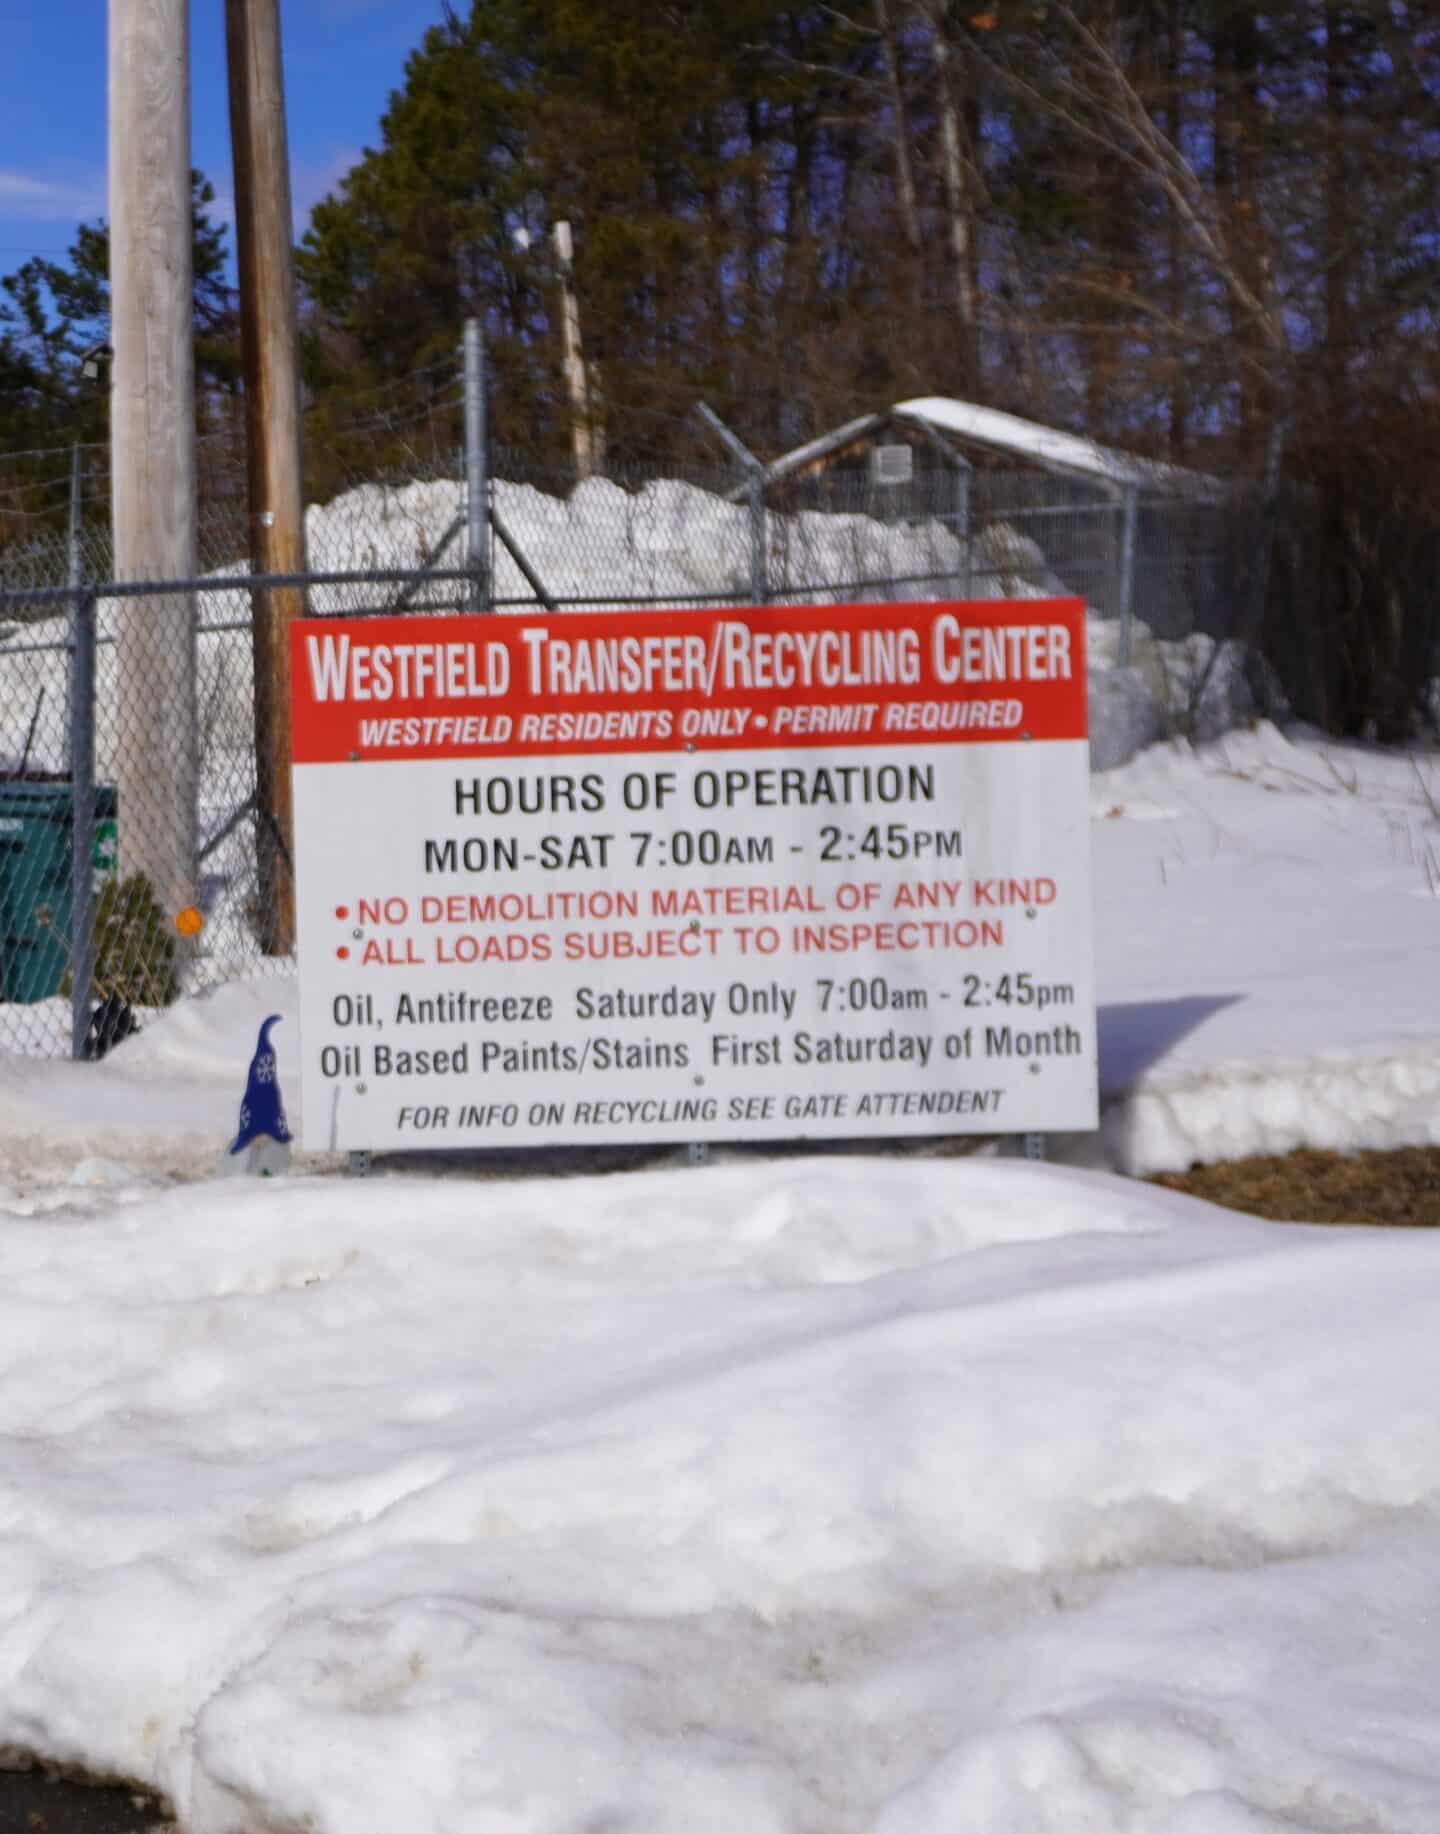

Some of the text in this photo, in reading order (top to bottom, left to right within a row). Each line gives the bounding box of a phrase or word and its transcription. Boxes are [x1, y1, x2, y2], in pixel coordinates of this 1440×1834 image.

[306, 634, 509, 702] WESTFIELD
[932, 614, 1071, 684] CENTER
[360, 699, 1023, 747] WESTFIELD RESIDENTS ONLY PERMIT REQUIRED
[455, 764, 934, 815] HOURS OF OPERATION
[424, 835, 614, 872] MON-SAT
[630, 829, 773, 867] 7:00AM
[819, 823, 961, 862] 2:45PM
[359, 877, 1057, 926] NO DEMOLITION MATERIAL OF ANY KIND
[362, 919, 1003, 966] ALL LOADS SUBJECT TO INSPECTION
[333, 995, 383, 1030] Oil,
[396, 992, 553, 1025] Antifreeze
[575, 985, 715, 1023] Saturday
[728, 981, 796, 1021] Only
[816, 977, 928, 1012] 7:00am
[963, 972, 1074, 1011] 2:45pm
[321, 1024, 1082, 1078] Oil Based Paints/Stains First Saturday of Month
[397, 1088, 1006, 1130] FOR INFO ON RECYCLING SEE GATE ATTENDENT
